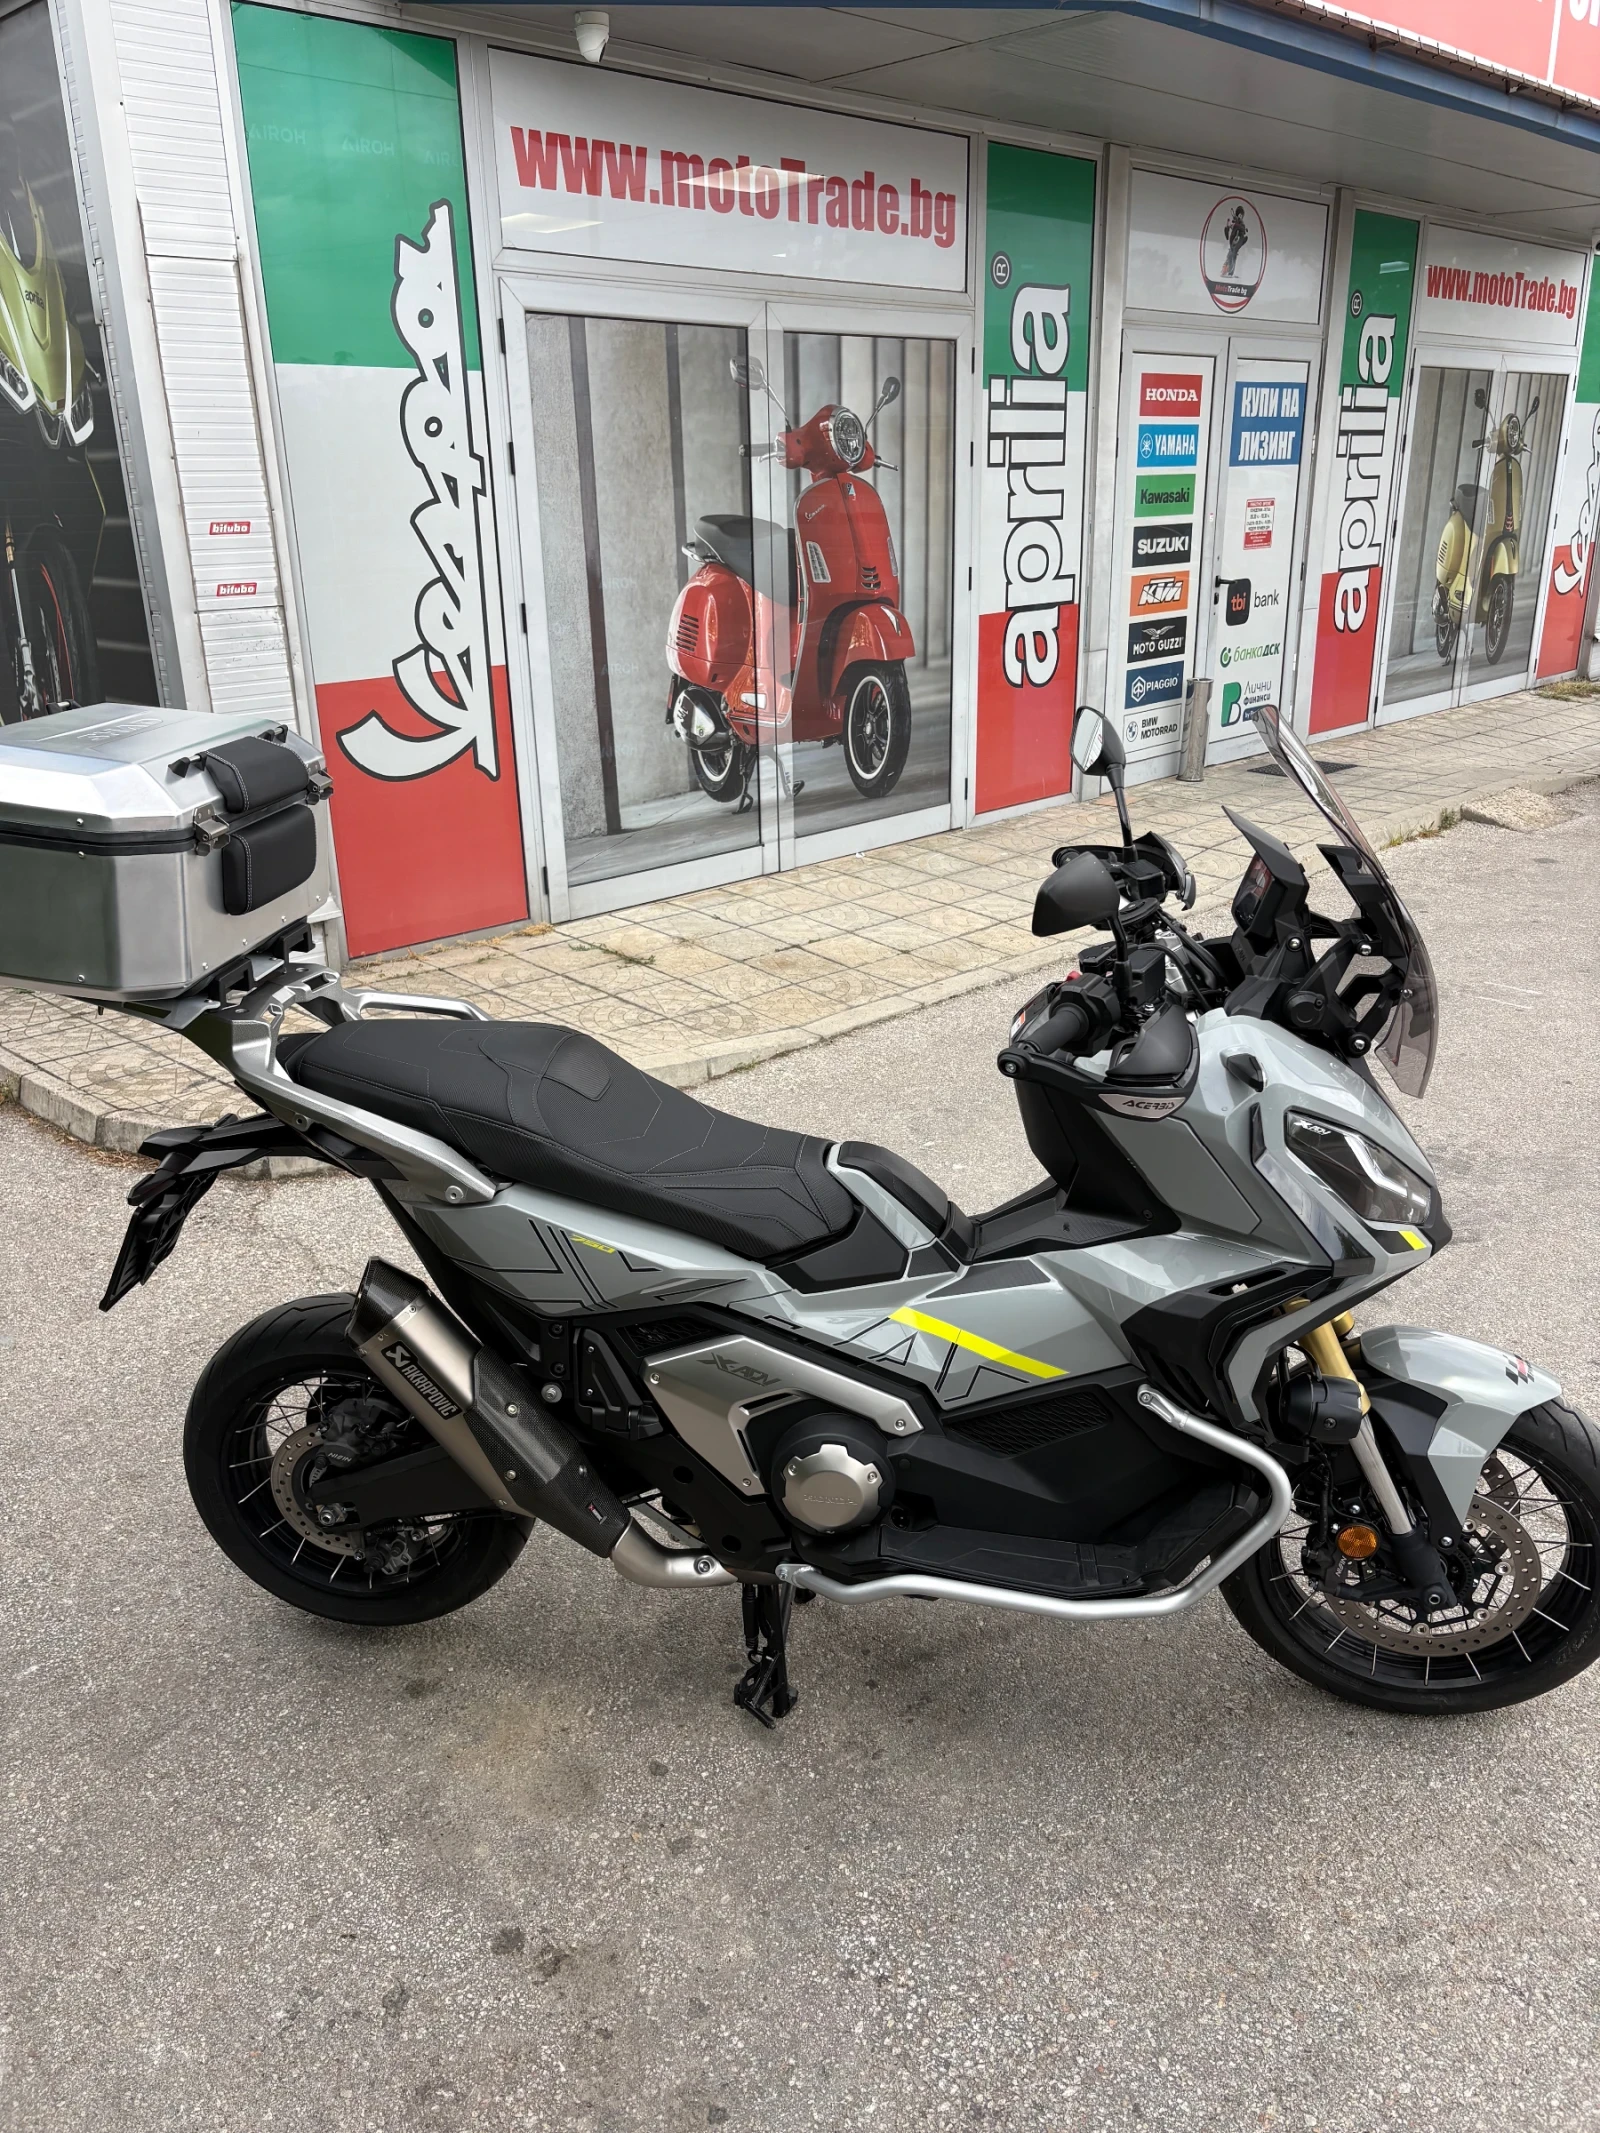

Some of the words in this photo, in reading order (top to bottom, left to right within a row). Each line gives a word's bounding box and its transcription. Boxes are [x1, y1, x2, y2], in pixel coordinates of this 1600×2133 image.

[510, 126, 956, 248] www.motoTrade.bg
[1427, 265, 1577, 319] www.motoTrade.bg
[1145, 388, 1198, 401] HONDA
[1241, 387, 1279, 417] КУПИ
[1281, 388, 1300, 417] НА
[1155, 434, 1195, 456] YAMAHA
[1238, 431, 1296, 461] ЛИЗИНГ
[1334, 313, 1396, 632] aprilia
[987, 282, 1076, 688] aprilia
[1140, 488, 1190, 505] Kawasaki
[212, 523, 248, 533] bitubo
[1137, 536, 1189, 555] SUZUKI
[219, 585, 255, 595] bitubo
[1138, 577, 1183, 606] KTM
[1231, 592, 1247, 611] tbi
[1254, 589, 1279, 608] bank
[1132, 641, 1155, 655] MOTO
[1158, 637, 1182, 651] GUZZI
[1146, 677, 1178, 691] PIAGGIO
[1141, 716, 1158, 728] BMW
[1141, 723, 1178, 740] MOTORRAD
